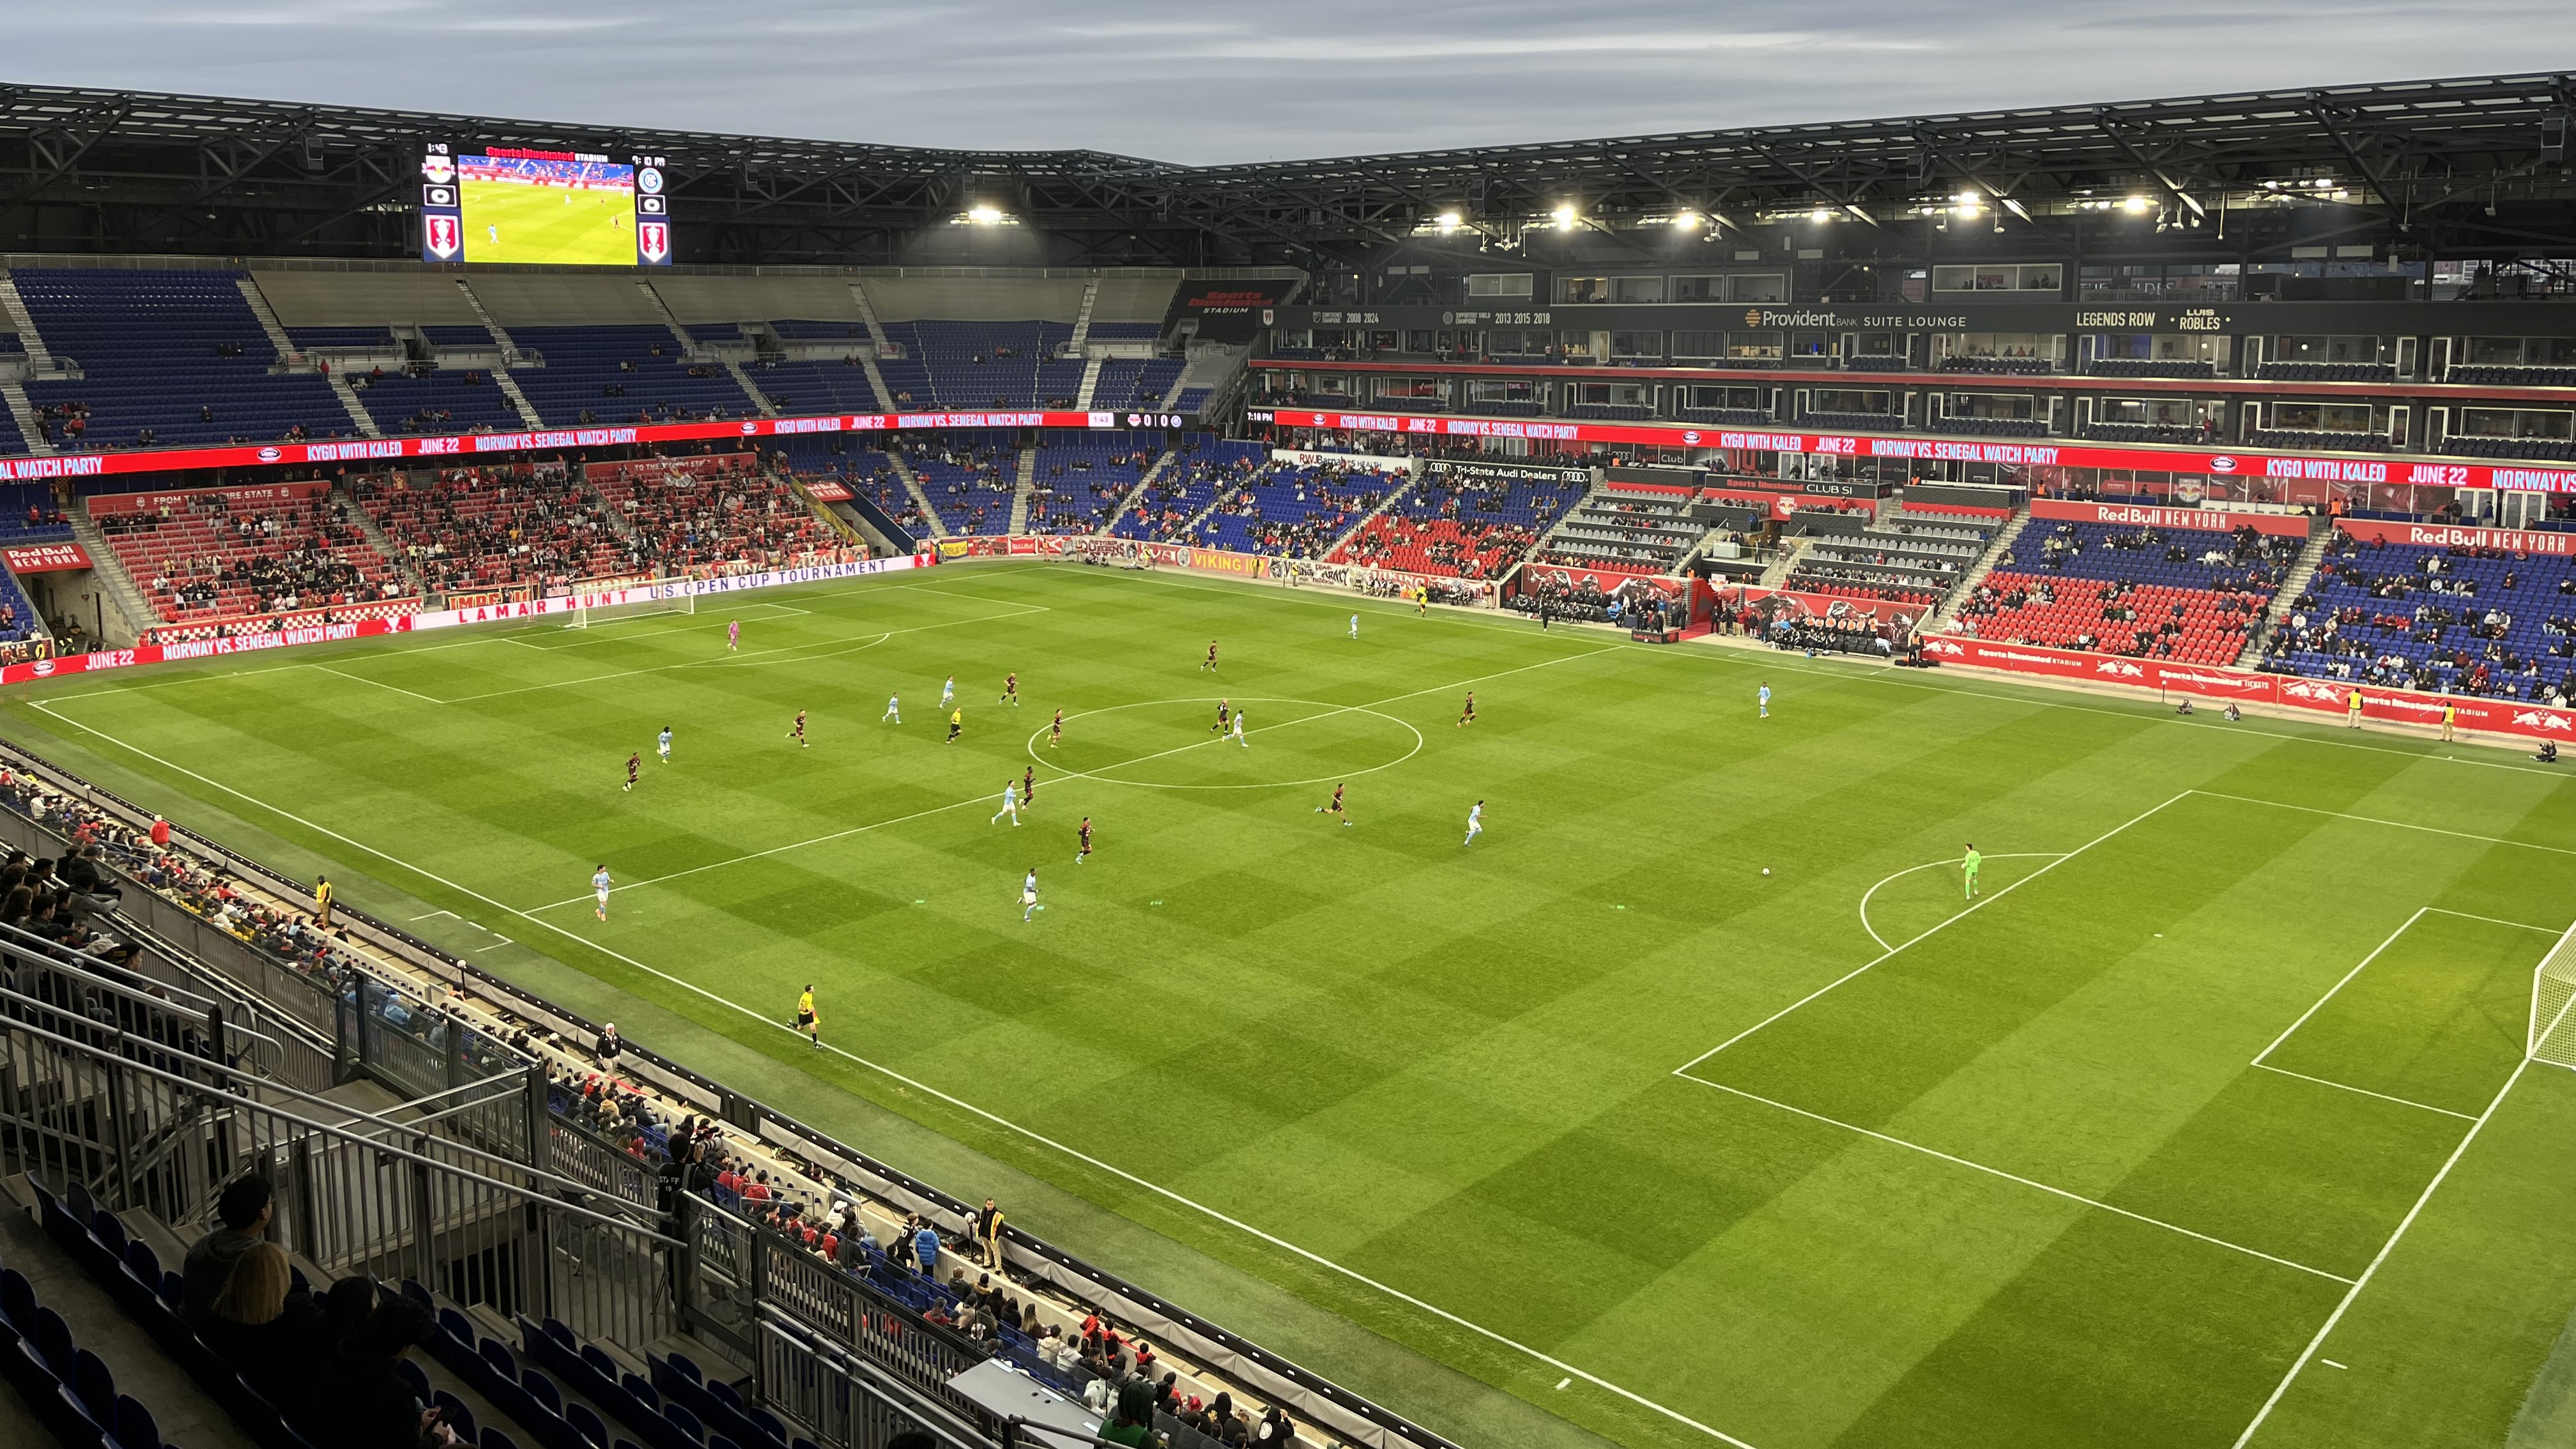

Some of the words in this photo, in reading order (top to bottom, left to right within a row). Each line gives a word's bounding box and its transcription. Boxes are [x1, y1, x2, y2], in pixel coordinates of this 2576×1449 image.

[427, 143, 448, 154] 1:43
[486, 146, 522, 158] Sports
[575, 153, 608, 162] STADIUM
[1346, 312, 1361, 323] 2008
[1363, 312, 1379, 323] 2024
[1495, 312, 1512, 324] 2013
[1514, 312, 1531, 324] 2015
[1533, 312, 1551, 325] 2018
[1762, 310, 1836, 326] Provident
[1836, 319, 1858, 327] BANK
[1863, 317, 1903, 327] SUITE
[1908, 316, 1966, 327] LOUNGE
[2076, 312, 2126, 326] LEGENDS
[2129, 312, 2156, 326] ROW
[2179, 317, 2220, 330] ROBLES
[851, 417, 873, 429] JUNE
[873, 416, 885, 428] 22
[898, 414, 935, 428] NORWAY
[934, 413, 947, 427] VS.
[949, 413, 986, 427] SENEGAL
[987, 413, 1016, 427] WATCH
[1018, 412, 1044, 426] PARTY
[1144, 414, 1151, 426] 0
[1160, 414, 1168, 427] 0
[1247, 411, 1261, 422] 7:10
[1262, 413, 1273, 422] PM
[1340, 415, 1358, 428] KYGO
[1358, 415, 1376, 429] WITH
[1376, 416, 1398, 431] KALEO
[774, 420, 795, 434] KYGO
[795, 419, 816, 433] WITH
[817, 418, 840, 431] KALEO
[1407, 418, 1426, 431] JUNE
[1426, 419, 1436, 432] 22
[1447, 420, 1480, 435] NORWAY
[1478, 422, 1491, 436] VS.
[1492, 422, 1525, 437] SENEGAL
[1525, 424, 1553, 438] WATCH
[1554, 425, 1578, 440] PARTY
[418, 439, 445, 454] JUNE
[445, 437, 459, 452] 22
[475, 434, 518, 451] NORWAY
[518, 433, 533, 448] VS.
[535, 431, 576, 448] SENEGAL
[576, 430, 608, 445] WATCH
[610, 428, 637, 443] PARTY
[1721, 432, 1744, 448] KYGO
[1745, 433, 1771, 449] WITH
[1771, 434, 1801, 451] KALEO
[1815, 436, 1842, 452] JUNE
[1841, 438, 1855, 453] 22
[307, 444, 337, 461] KYGO
[338, 443, 367, 459] WITH
[369, 441, 402, 457] KALEO
[1636, 452, 1658, 463] Audi
[1661, 454, 1683, 464] Club
[1871, 439, 1916, 457] NORWAY
[1915, 442, 1933, 458] VS.
[1934, 443, 1983, 461] SENEGAL
[1984, 445, 2022, 463] WATCH
[2023, 447, 2058, 464] PARTY
[14, 459, 61, 479] WATCH
[64, 457, 102, 475] PARTY
[1456, 466, 1496, 477] Tri-State
[1496, 467, 1519, 478] Audi
[1521, 469, 1557, 480] Dealers
[2266, 458, 2301, 477] KYGO
[2304, 460, 2340, 480] WITH
[2342, 461, 2386, 482] KALEO
[2407, 464, 2446, 484] JUNE
[2448, 466, 2467, 486] 22
[1727, 479, 1756, 488] Sports
[1806, 484, 1839, 493] CLUB
[1841, 486, 1852, 494] SI
[2492, 469, 2559, 491] NORWAY
[153, 495, 181, 505] FROM
[244, 489, 273, 498] STATE
[2097, 506, 2129, 522] Red
[2129, 508, 2161, 524] Bull
[2165, 512, 2191, 526] NEW
[2194, 513, 2226, 529] YORK
[2411, 526, 2446, 543] Red
[2449, 528, 2487, 547] Bull
[2493, 532, 2524, 550] NEW
[2528, 533, 2566, 552] YORK
[8, 548, 43, 559] Red
[41, 545, 74, 555] Bull
[13, 557, 42, 568] NEW
[43, 553, 80, 565] YORK
[1193, 552, 1242, 572] VIKING
[684, 578, 728, 595] OPEN
[739, 574, 769, 588] CUP
[779, 560, 886, 583] TOURNAMENT
[459, 600, 546, 623] LAMAR
[566, 590, 627, 610] HUNT
[162, 643, 215, 661] NORWAY
[214, 640, 234, 655] VS.
[235, 634, 285, 651] SENEGAL
[285, 629, 323, 645] WATCH
[325, 624, 358, 640] PARTY
[85, 652, 118, 671] JUNE
[118, 650, 135, 666] 22
[1978, 648, 2007, 658] Sports
[2159, 670, 2192, 680] Sports
[2244, 680, 2269, 689] TICKETS
[2362, 696, 2391, 706] ports
[2456, 708, 2488, 717] TADIUM
[659, 1176, 680, 1184] STFF
